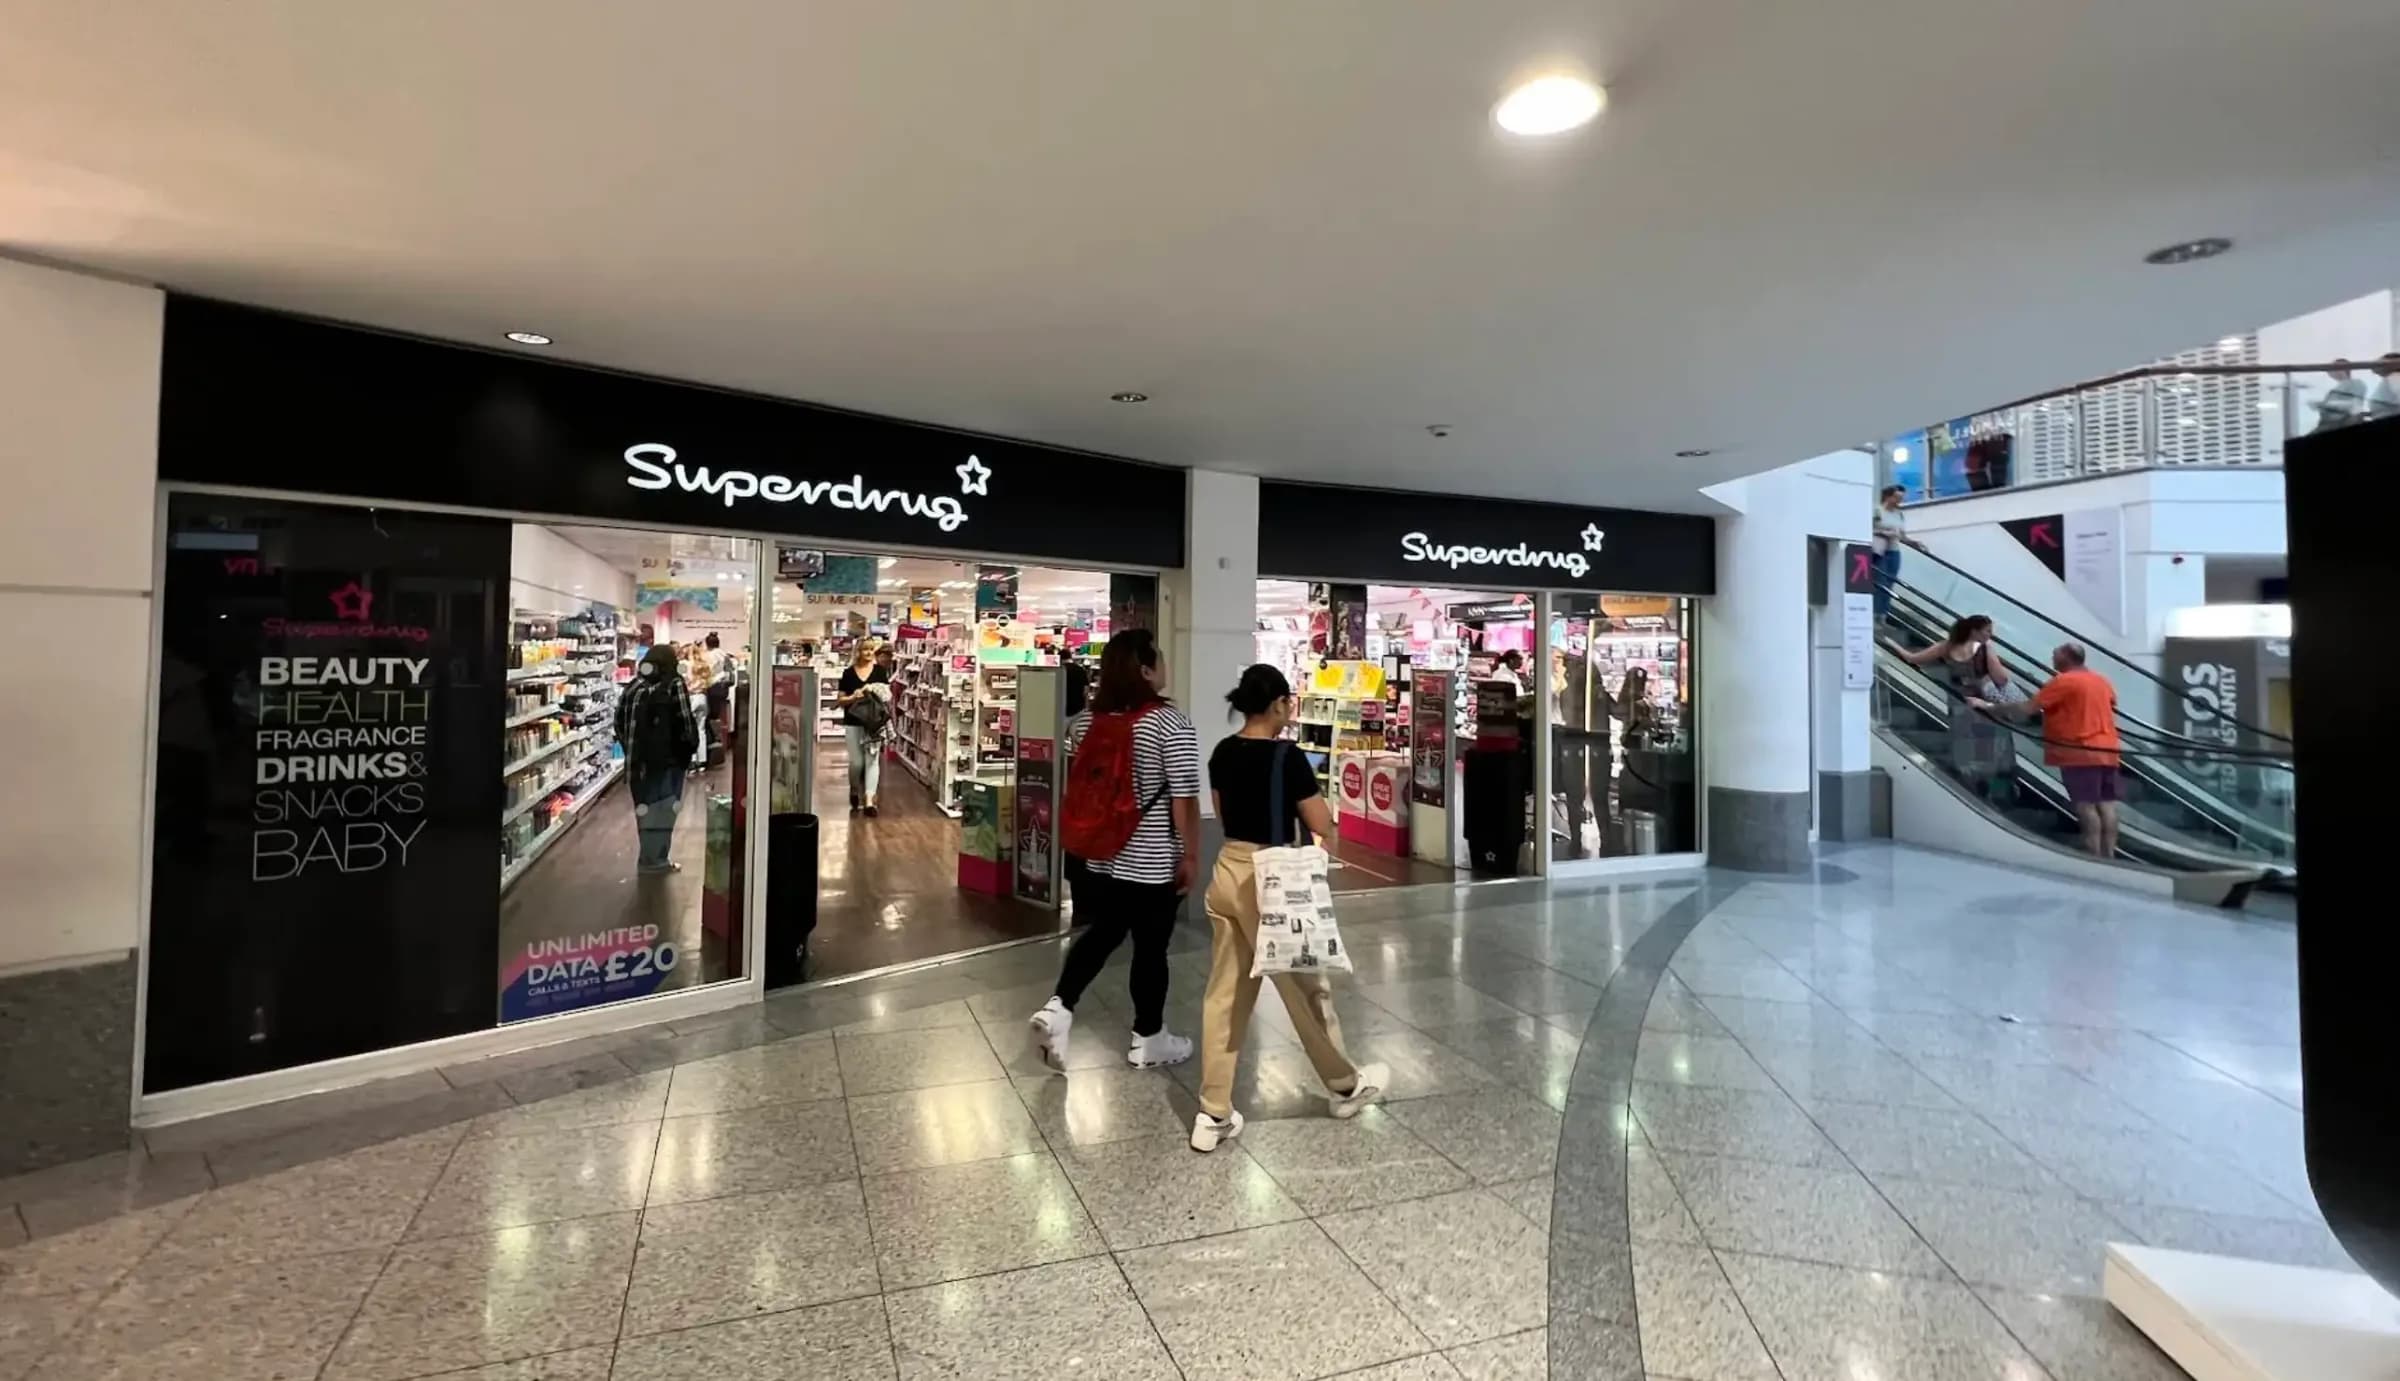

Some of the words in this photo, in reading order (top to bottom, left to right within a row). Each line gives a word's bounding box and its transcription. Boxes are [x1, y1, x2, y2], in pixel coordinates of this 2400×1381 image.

[624, 443, 968, 532] Superdrug
[1400, 532, 1591, 578] Superdrug
[262, 616, 430, 643] Superdrug
[259, 656, 430, 686] BEAUTY
[257, 689, 430, 726] HEALTH
[256, 726, 427, 751] FRAGRANCE
[253, 782, 425, 824] SNACKS
[252, 819, 428, 882] BABY
[527, 923, 659, 959] UNLIMITED
[527, 955, 600, 985] DATA
[604, 941, 679, 982] £20
[528, 983, 561, 997] CALLS
[571, 976, 600, 989] TEXTS
